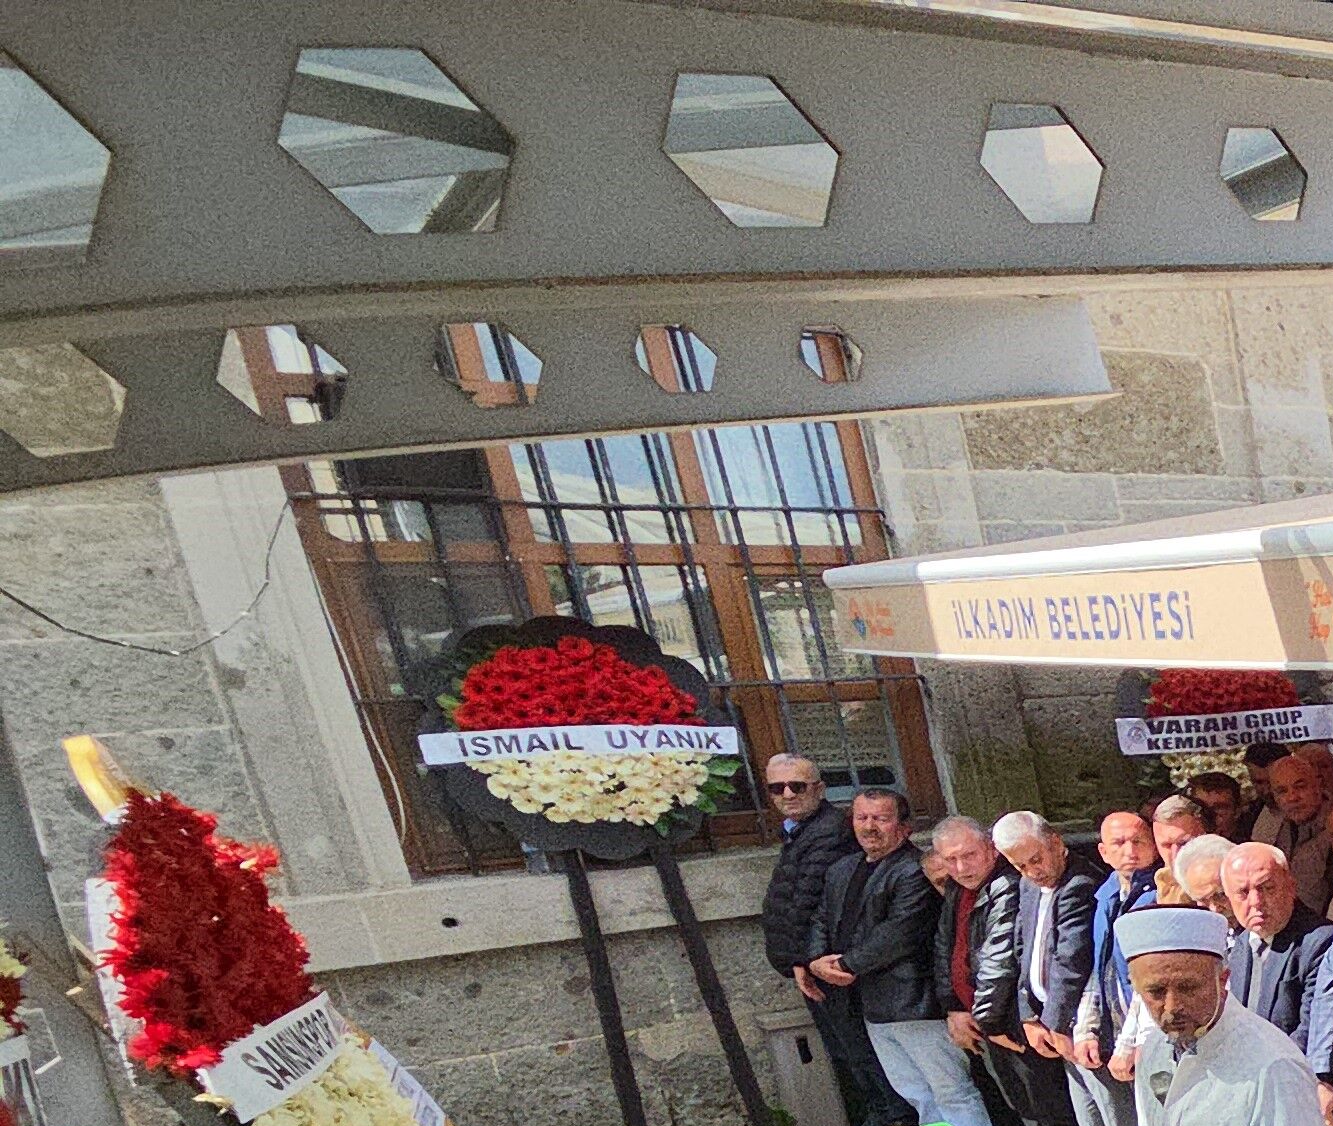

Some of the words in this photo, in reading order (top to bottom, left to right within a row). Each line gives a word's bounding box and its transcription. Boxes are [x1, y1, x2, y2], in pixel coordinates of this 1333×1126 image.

[1146, 715, 1238, 735] VARAN
[1244, 710, 1303, 730] GRUP
[604, 729, 723, 750] UYANIK
[1146, 734, 1220, 751] KEMAL
